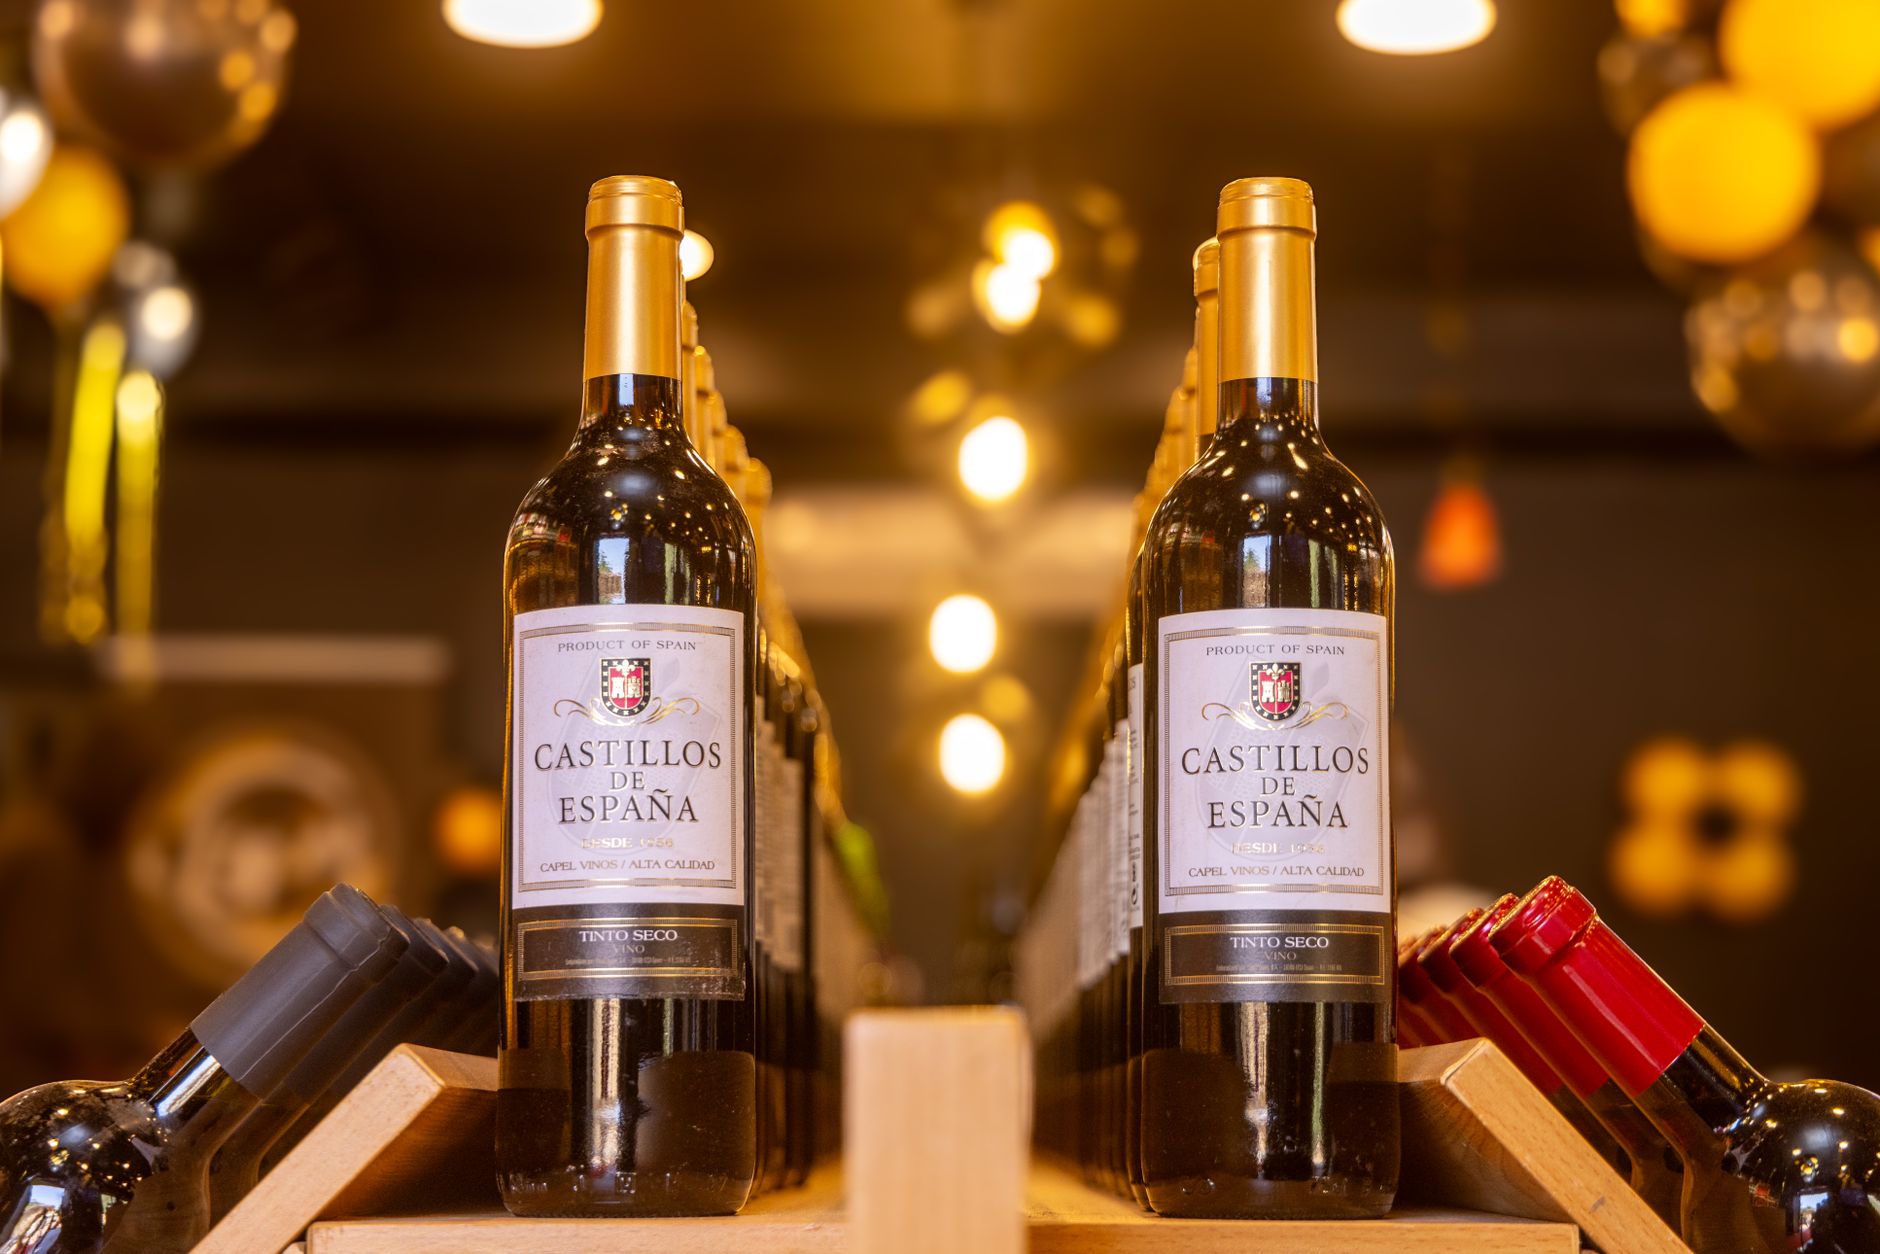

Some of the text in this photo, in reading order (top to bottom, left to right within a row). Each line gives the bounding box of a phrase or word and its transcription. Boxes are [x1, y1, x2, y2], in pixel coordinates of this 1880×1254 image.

[557, 640, 697, 653] PRODUCT OF SPAIN
[1206, 644, 1346, 656] PRODUCT OF SPAIN
[534, 740, 722, 771] CASTILLOS
[1181, 744, 1369, 776] CASTILLOS
[610, 771, 646, 791] DE
[1261, 777, 1296, 796] DE
[559, 788, 699, 824] ESPAÑA
[1207, 793, 1349, 829] ESPAÑA
[582, 837, 633, 849] DESDE
[540, 860, 576, 872] CAPEL
[580, 859, 618, 870] VINOS
[630, 859, 662, 869] ALTA
[664, 859, 716, 871] CALIDAD
[1188, 866, 1227, 877] CAPEL
[1230, 865, 1270, 876] VINOS
[1281, 865, 1312, 876] ALTA
[1316, 866, 1365, 877] CALIDAD
[578, 929, 678, 942] TINTO SECO
[613, 944, 646, 954] VINO
[1229, 936, 1330, 949] TINTO SECO
[1264, 951, 1297, 961] VINO
